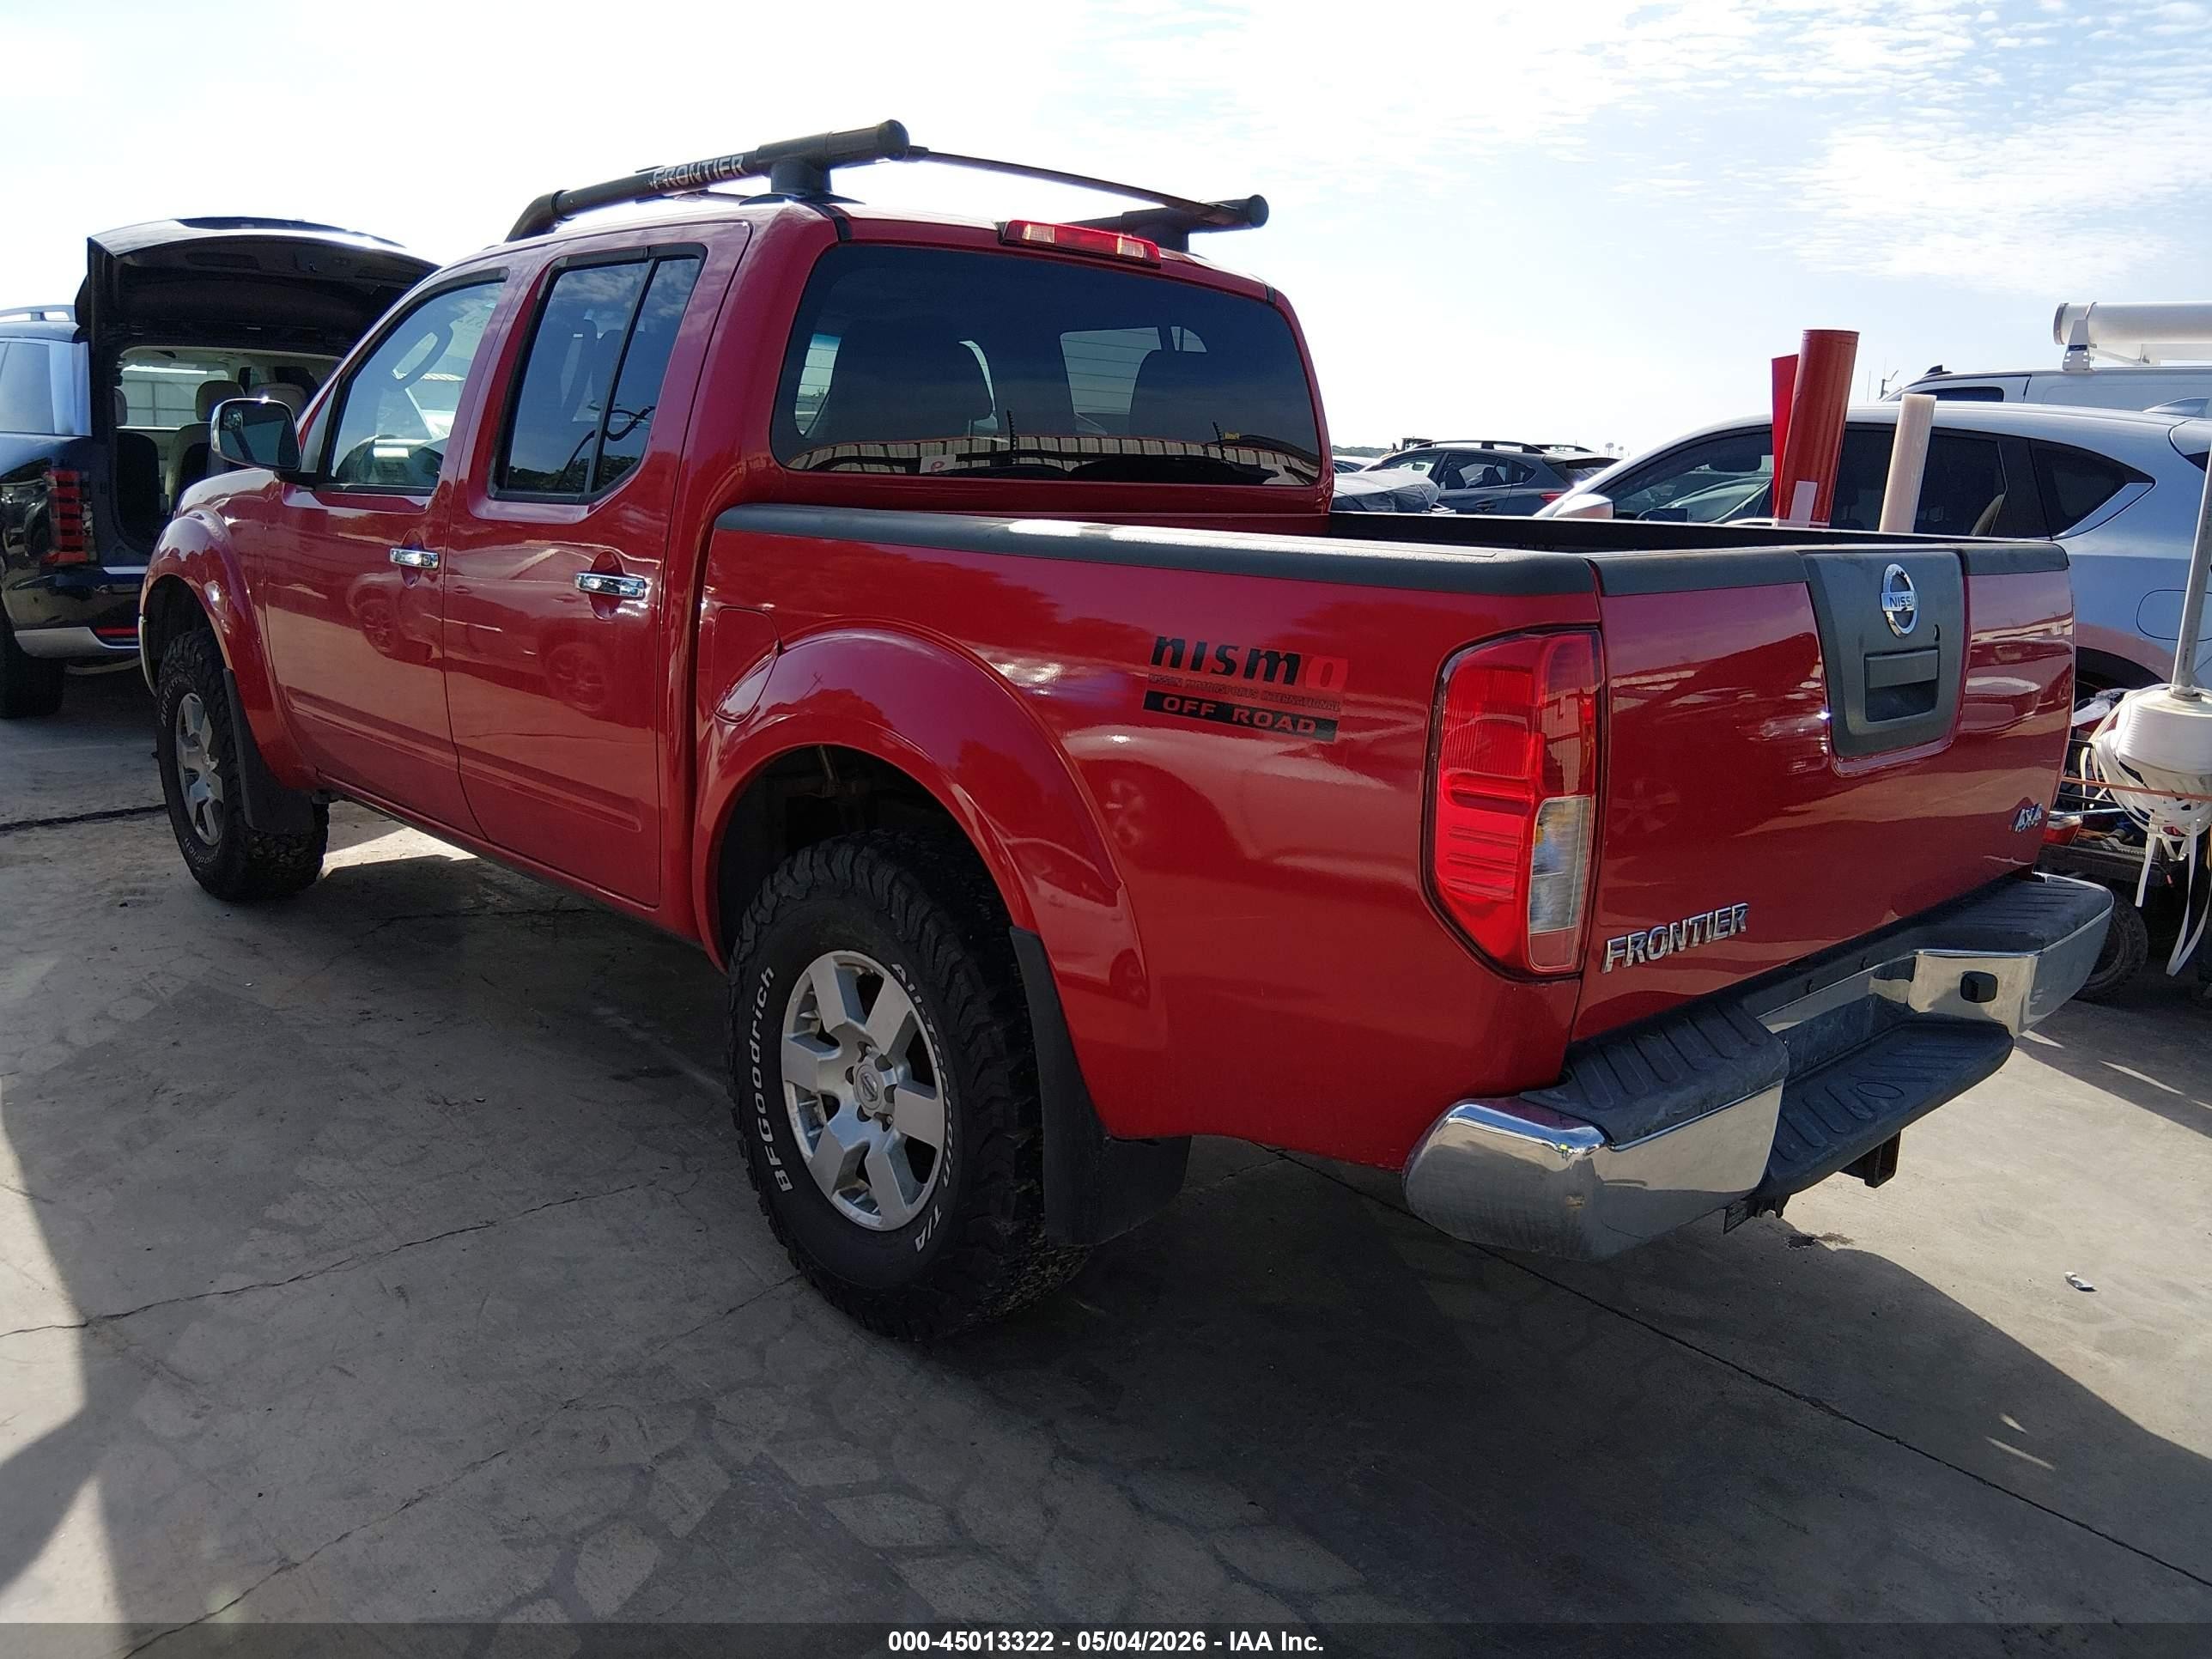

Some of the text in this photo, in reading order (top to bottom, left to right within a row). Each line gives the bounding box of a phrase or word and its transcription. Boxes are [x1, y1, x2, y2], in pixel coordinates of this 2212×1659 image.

[652, 155, 748, 190] FRONTIER
[1889, 594, 1914, 608] NISS
[1150, 635, 1349, 692] nismo
[1163, 696, 1317, 733] OFF ROAD
[1601, 902, 1750, 975] FRONTIER
[749, 966, 794, 1193] BFGoodrich
